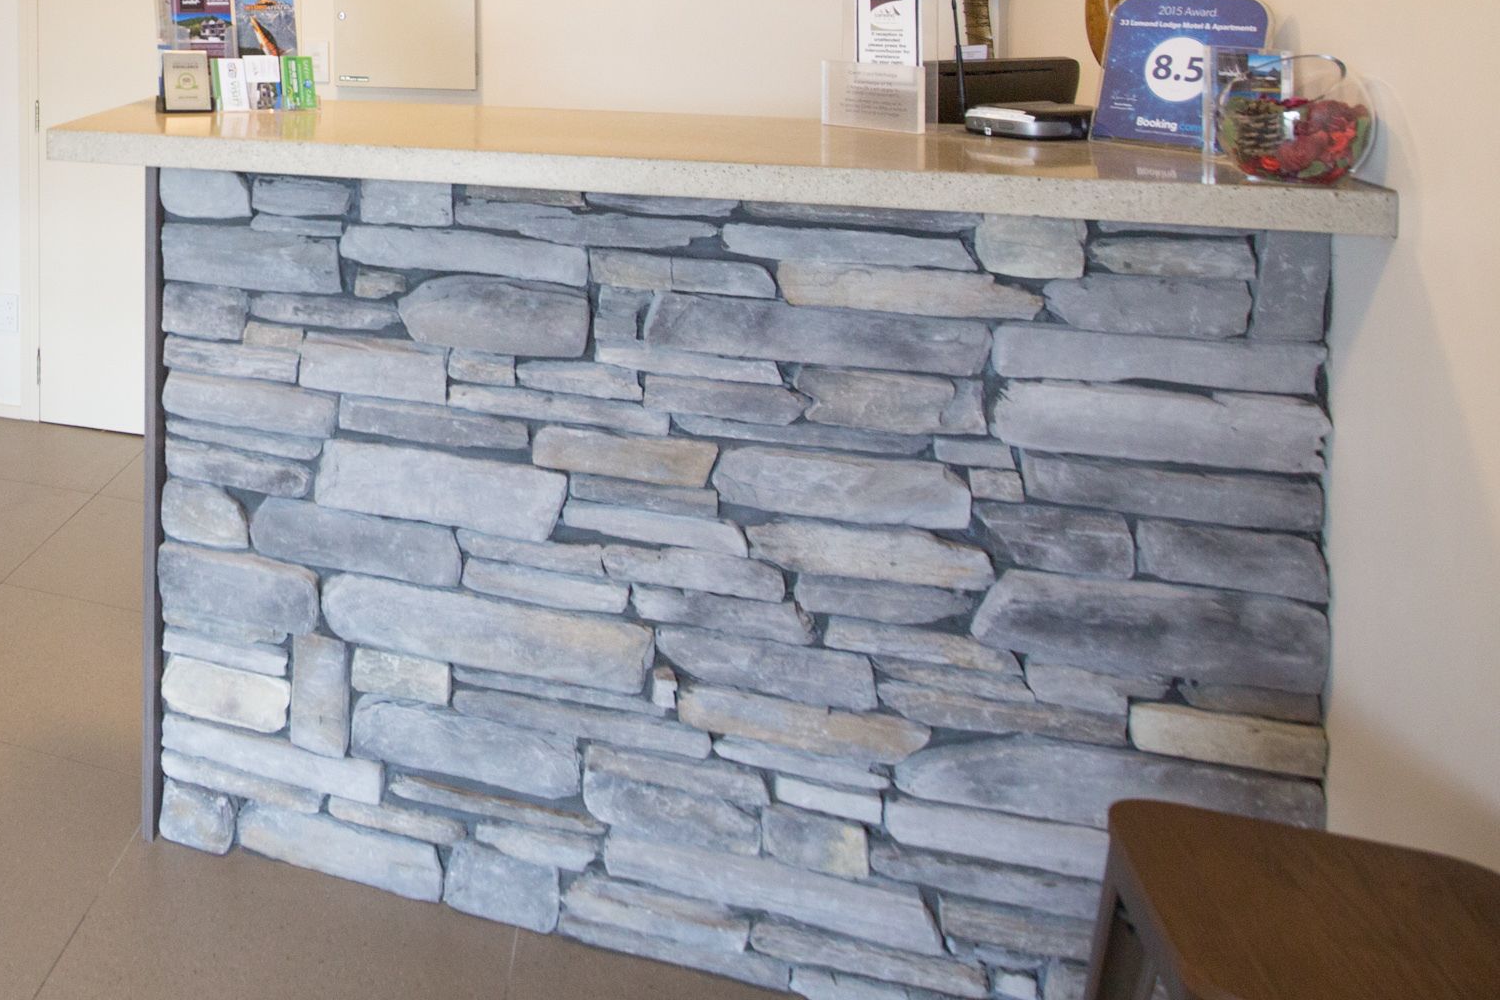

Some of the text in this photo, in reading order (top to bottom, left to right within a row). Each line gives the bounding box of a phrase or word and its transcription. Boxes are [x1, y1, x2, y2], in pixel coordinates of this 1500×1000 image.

[1158, 5, 1217, 18] 2015 Award
[1159, 21, 1179, 30] Lodge
[1181, 22, 1203, 30] Motel
[1212, 24, 1257, 33] Apartments
[1152, 53, 1203, 83] 8.5
